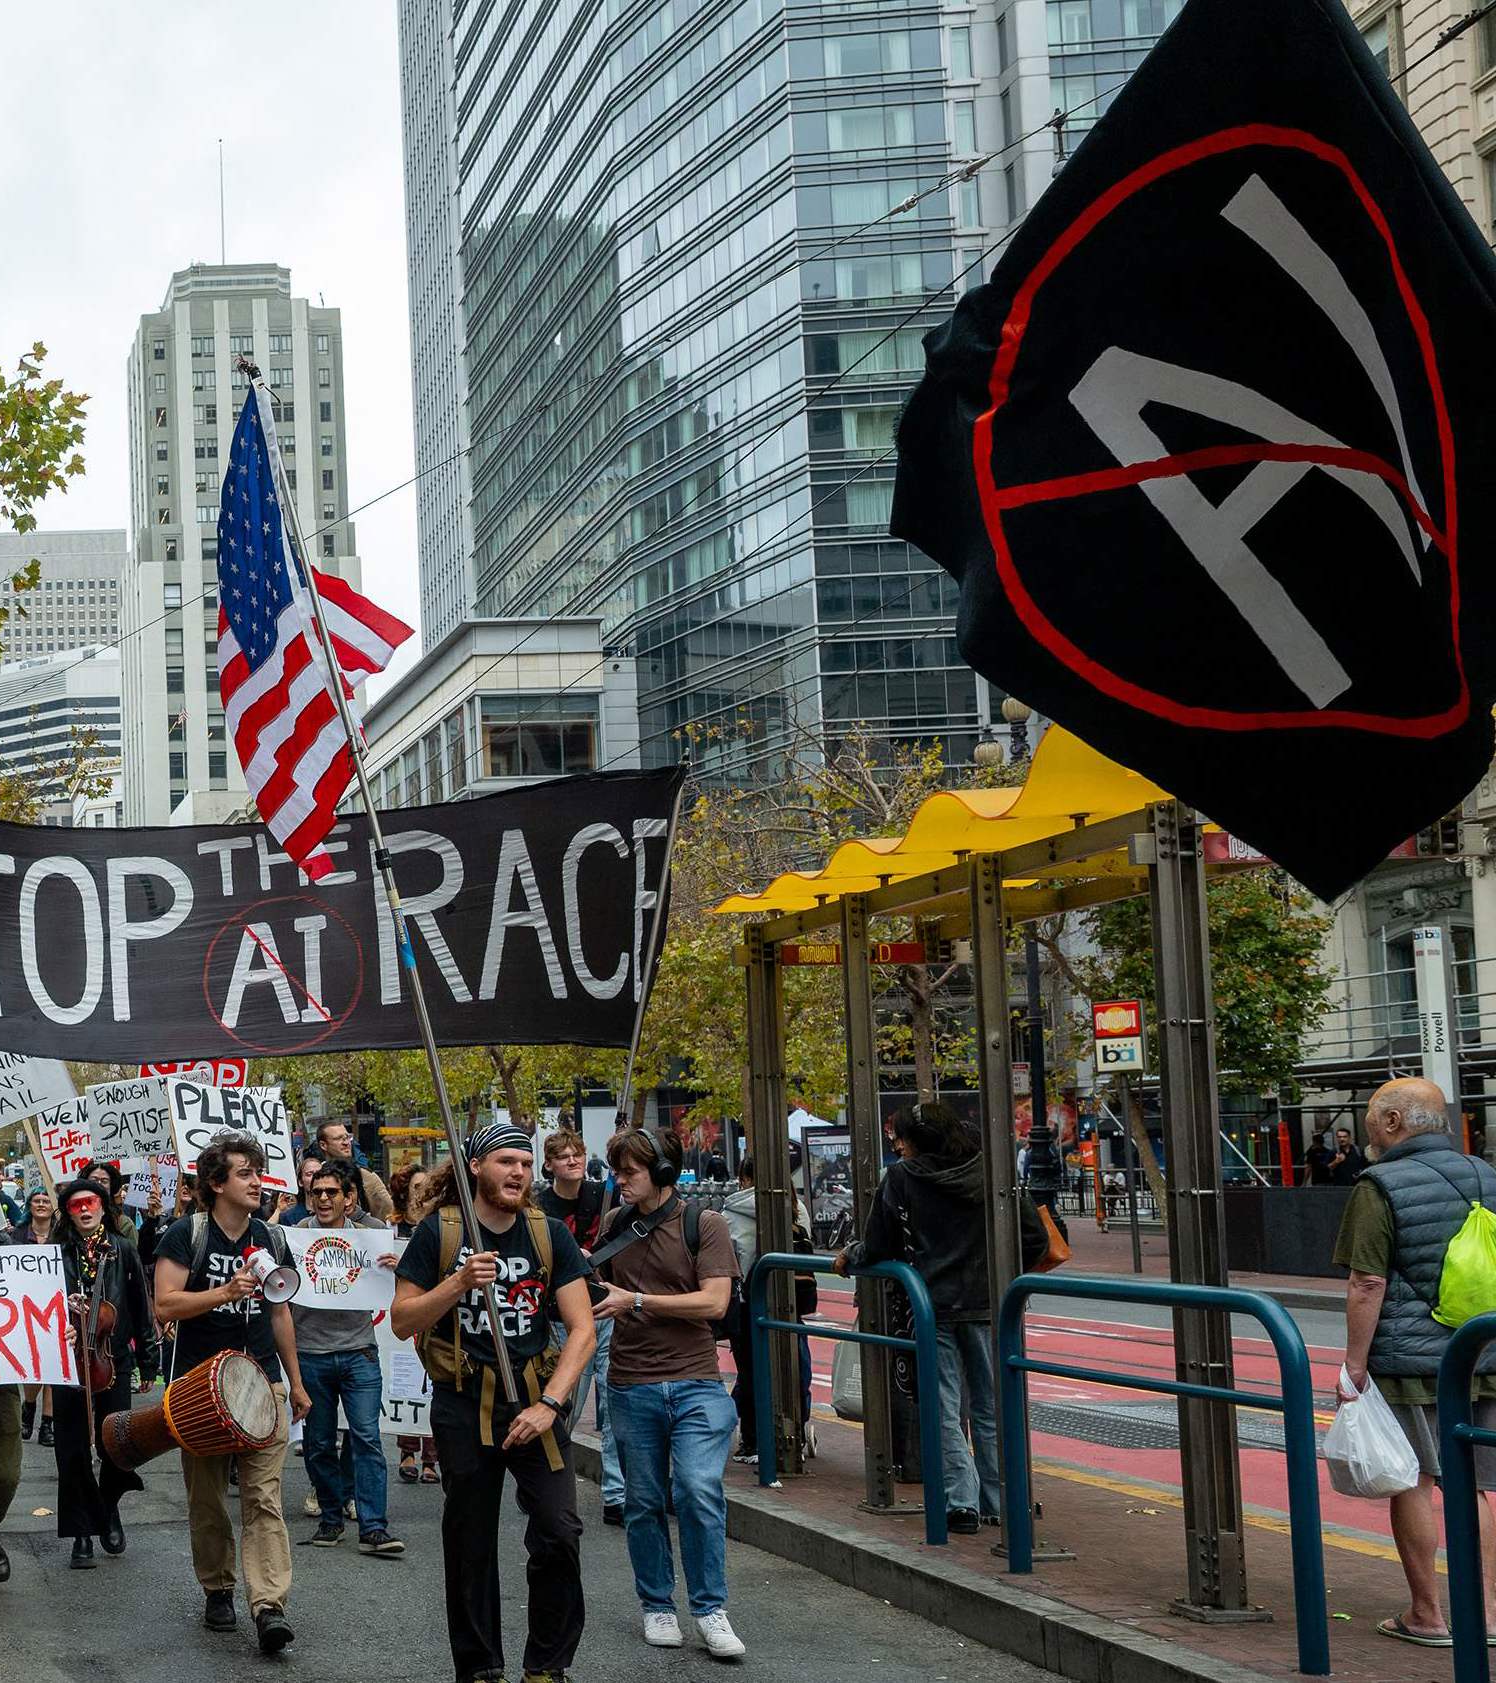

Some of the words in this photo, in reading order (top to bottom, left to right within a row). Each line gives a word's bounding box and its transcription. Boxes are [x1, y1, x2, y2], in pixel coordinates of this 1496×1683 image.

[221, 914, 334, 1030] AI
[1431, 1012, 1445, 1053] Powell
[94, 1085, 150, 1106] ENOUGH
[41, 1104, 74, 1126] We
[174, 1082, 285, 1136] PLEASE
[99, 1108, 169, 1141] SATISF
[133, 1139, 161, 1153] PAUSE
[134, 1172, 163, 1185] BEFOE
[209, 1252, 245, 1274] STO
[315, 1248, 371, 1269] GAMBLING
[455, 1246, 530, 1282] SOP
[314, 1277, 349, 1295] LIVES
